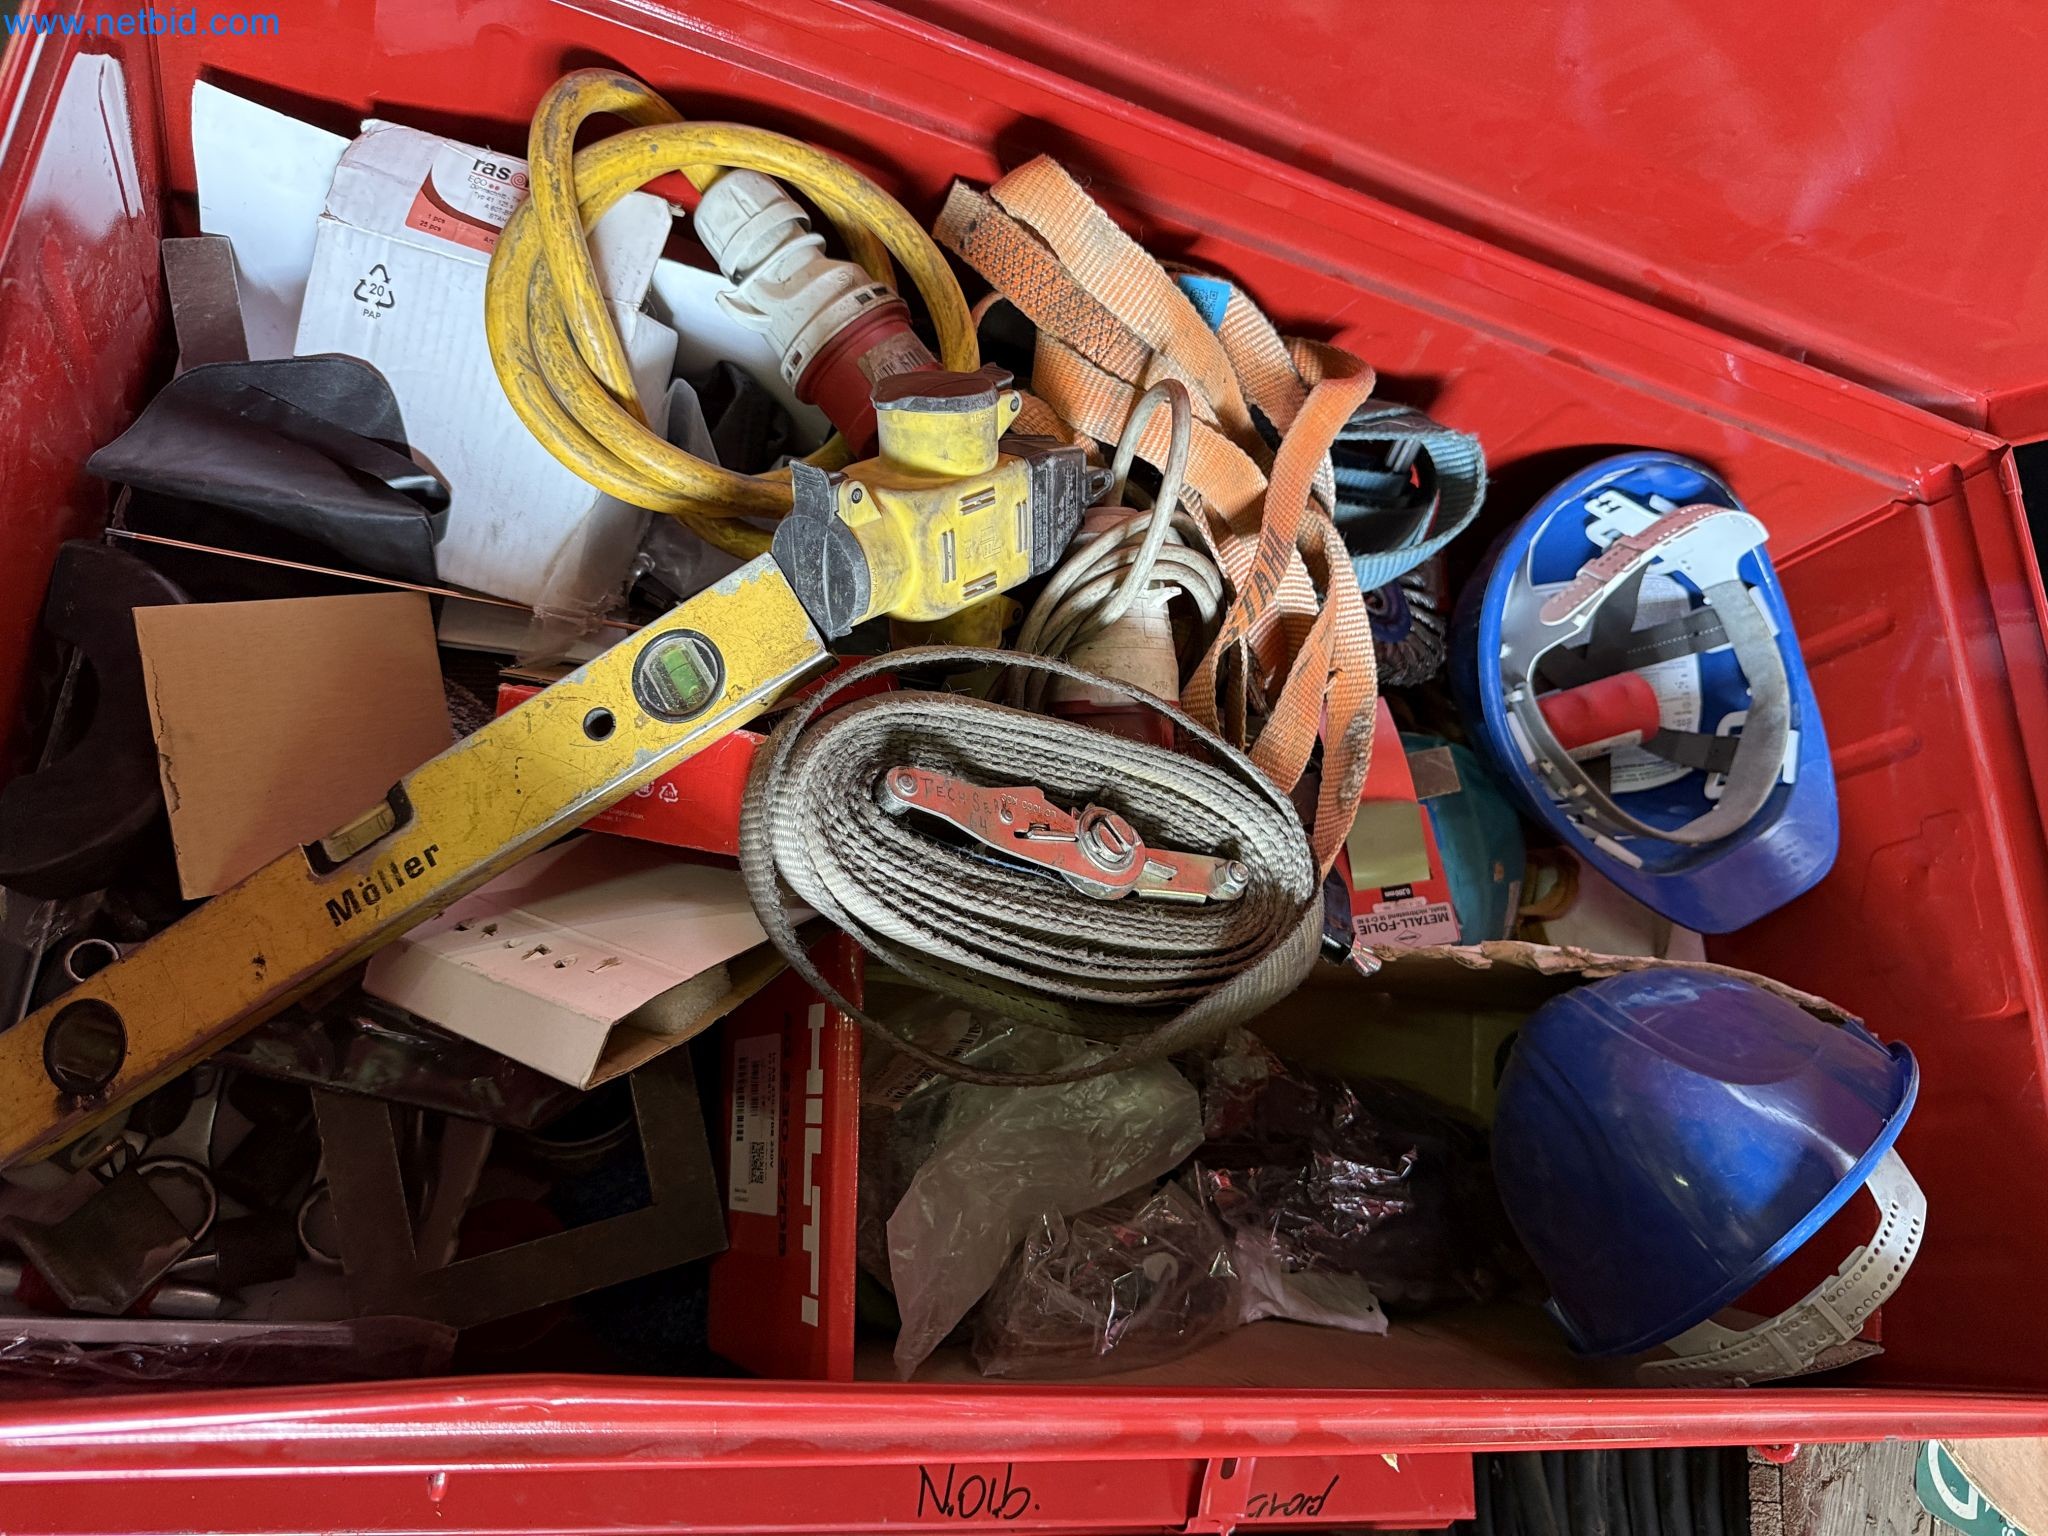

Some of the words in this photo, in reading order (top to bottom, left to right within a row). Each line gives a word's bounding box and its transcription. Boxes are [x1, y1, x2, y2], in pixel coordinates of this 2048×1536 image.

[468, 175, 488, 187] ECO
[419, 220, 428, 228] 25
[428, 224, 442, 233] pcs
[432, 216, 446, 224] pcs
[369, 282, 385, 297] 20
[362, 308, 382, 320] PAP
[325, 843, 440, 928] Möller
[1358, 911, 1450, 936] METALL-FOLIE
[801, 1002, 826, 1328] HILTI
